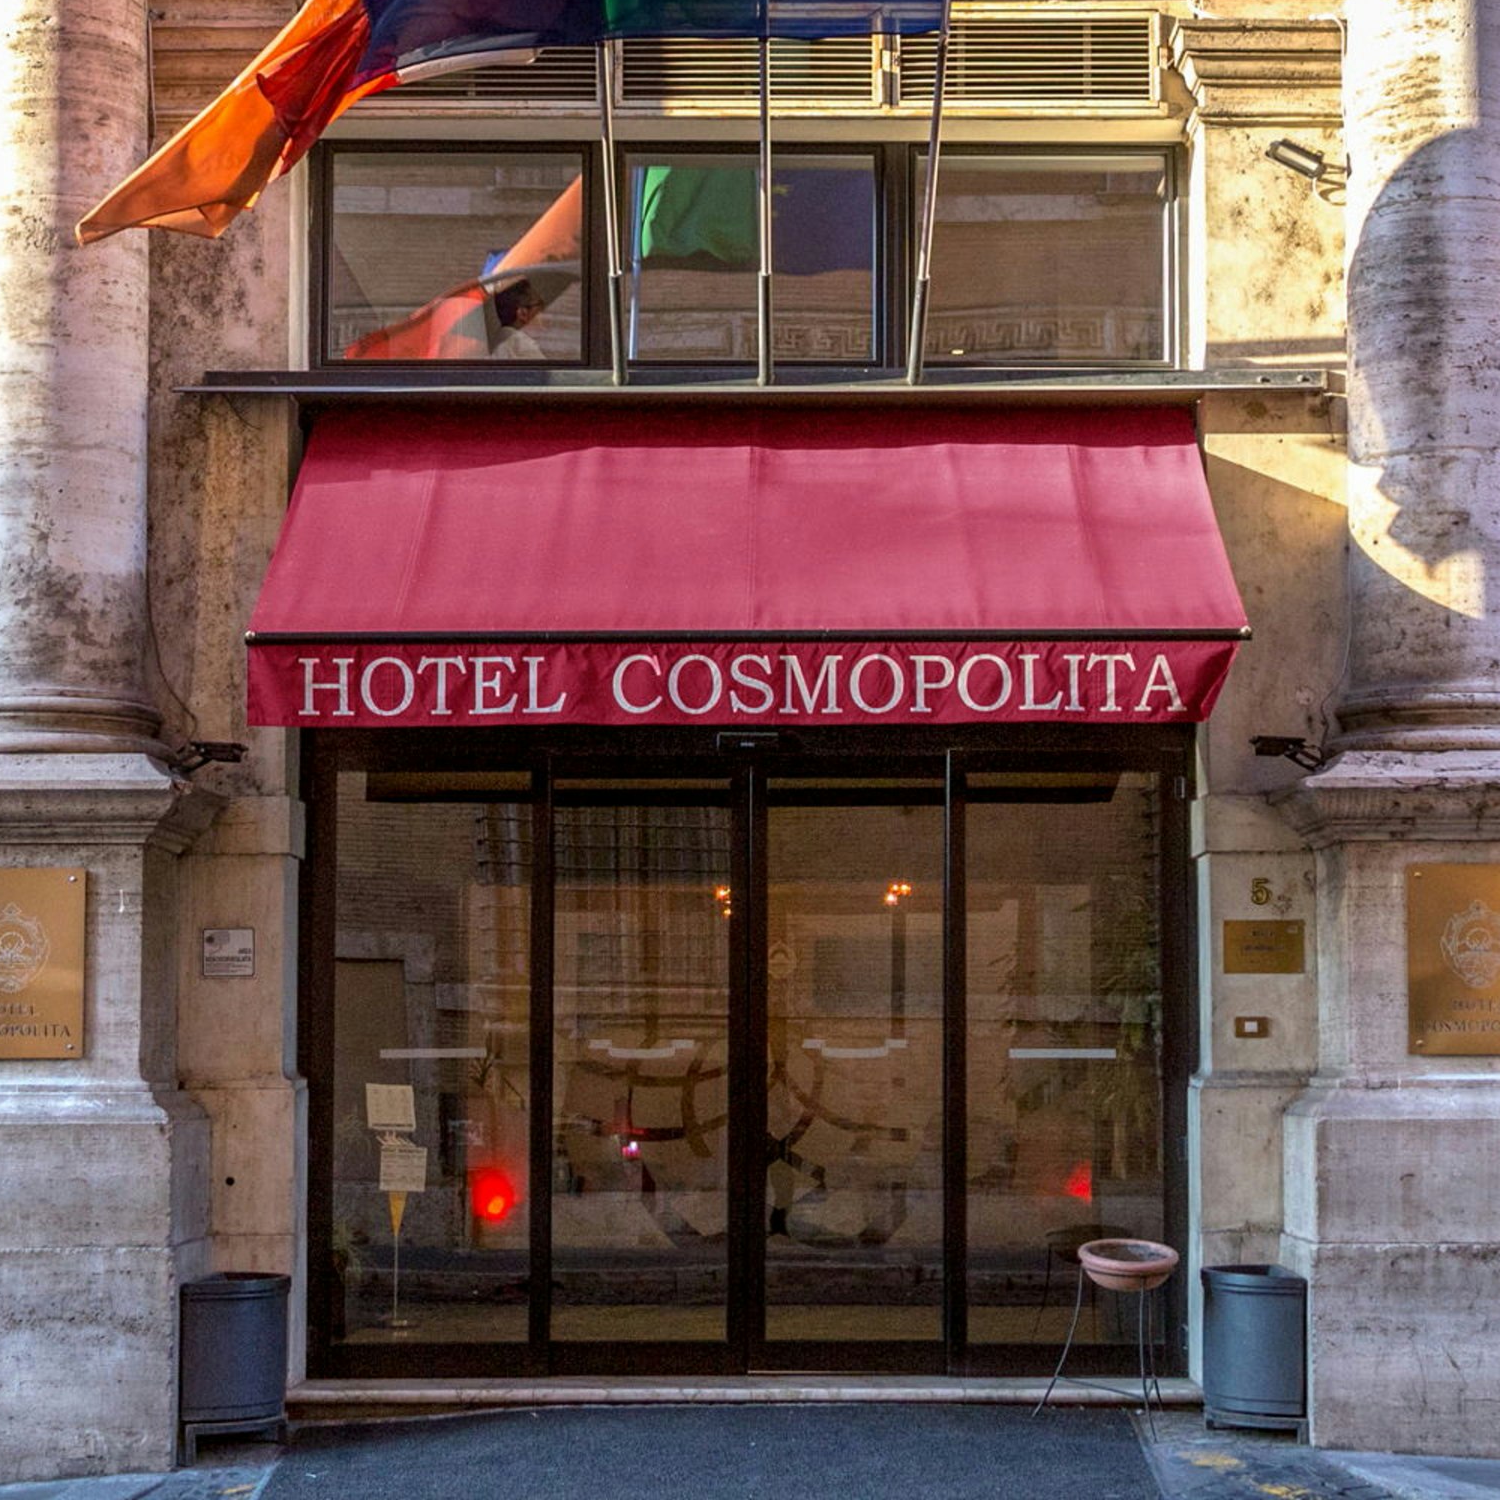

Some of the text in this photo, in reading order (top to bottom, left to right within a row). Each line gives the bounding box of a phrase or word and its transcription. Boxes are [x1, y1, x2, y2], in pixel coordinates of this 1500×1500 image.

[298, 652, 1188, 716] HOTEL COSMOPOLITA
[1251, 877, 1272, 906] 5
